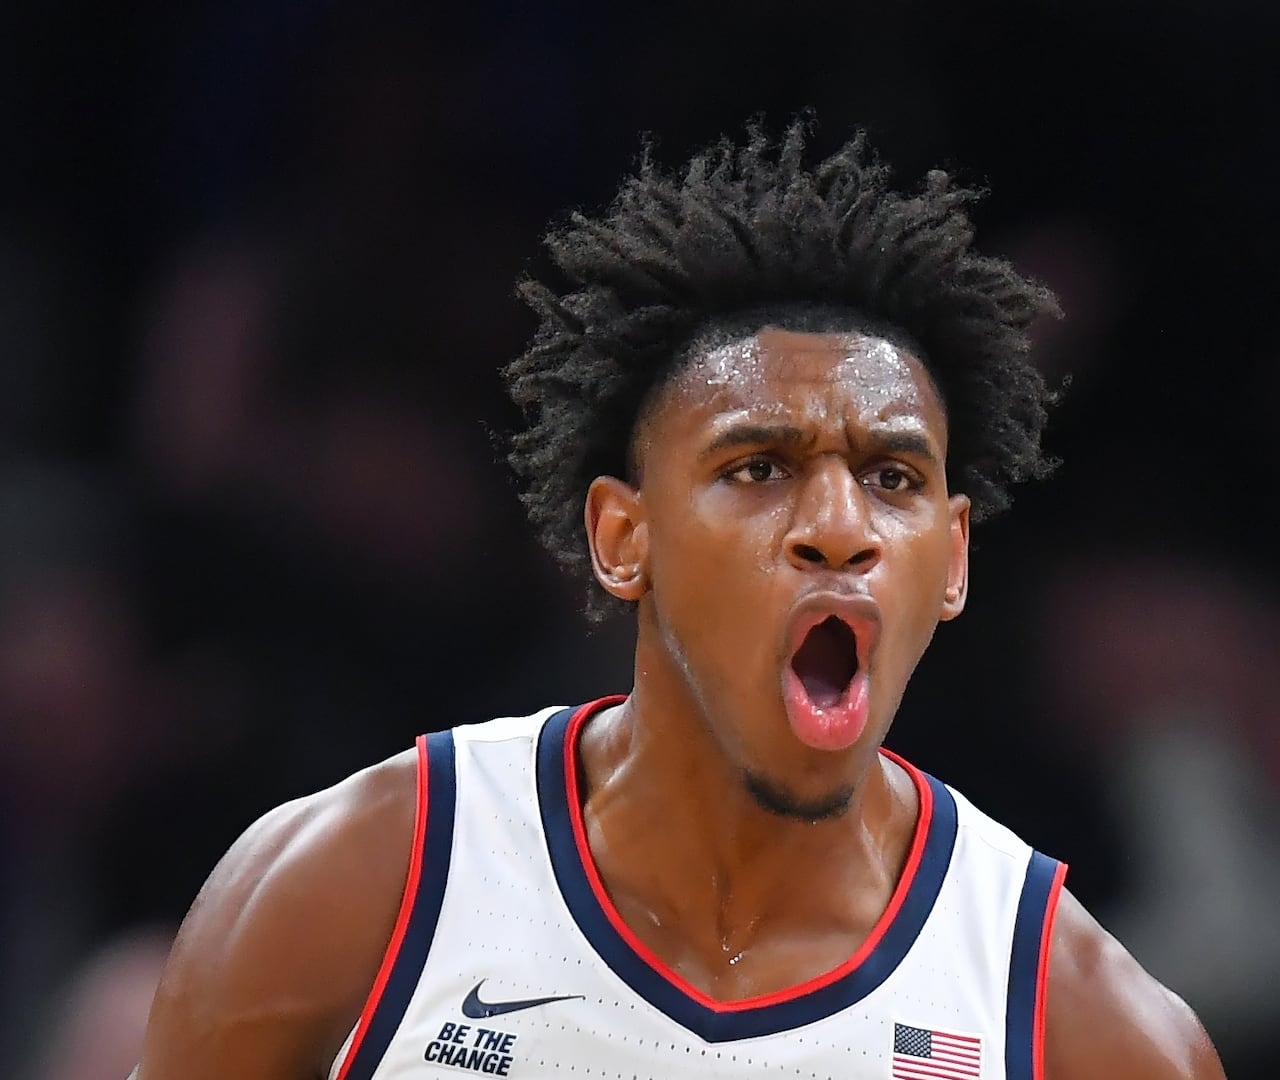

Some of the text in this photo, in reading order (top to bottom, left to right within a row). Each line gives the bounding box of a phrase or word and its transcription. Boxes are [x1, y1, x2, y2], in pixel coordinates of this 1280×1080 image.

[437, 1022, 517, 1054] BE THE
[424, 1041, 514, 1077] CHANGE
